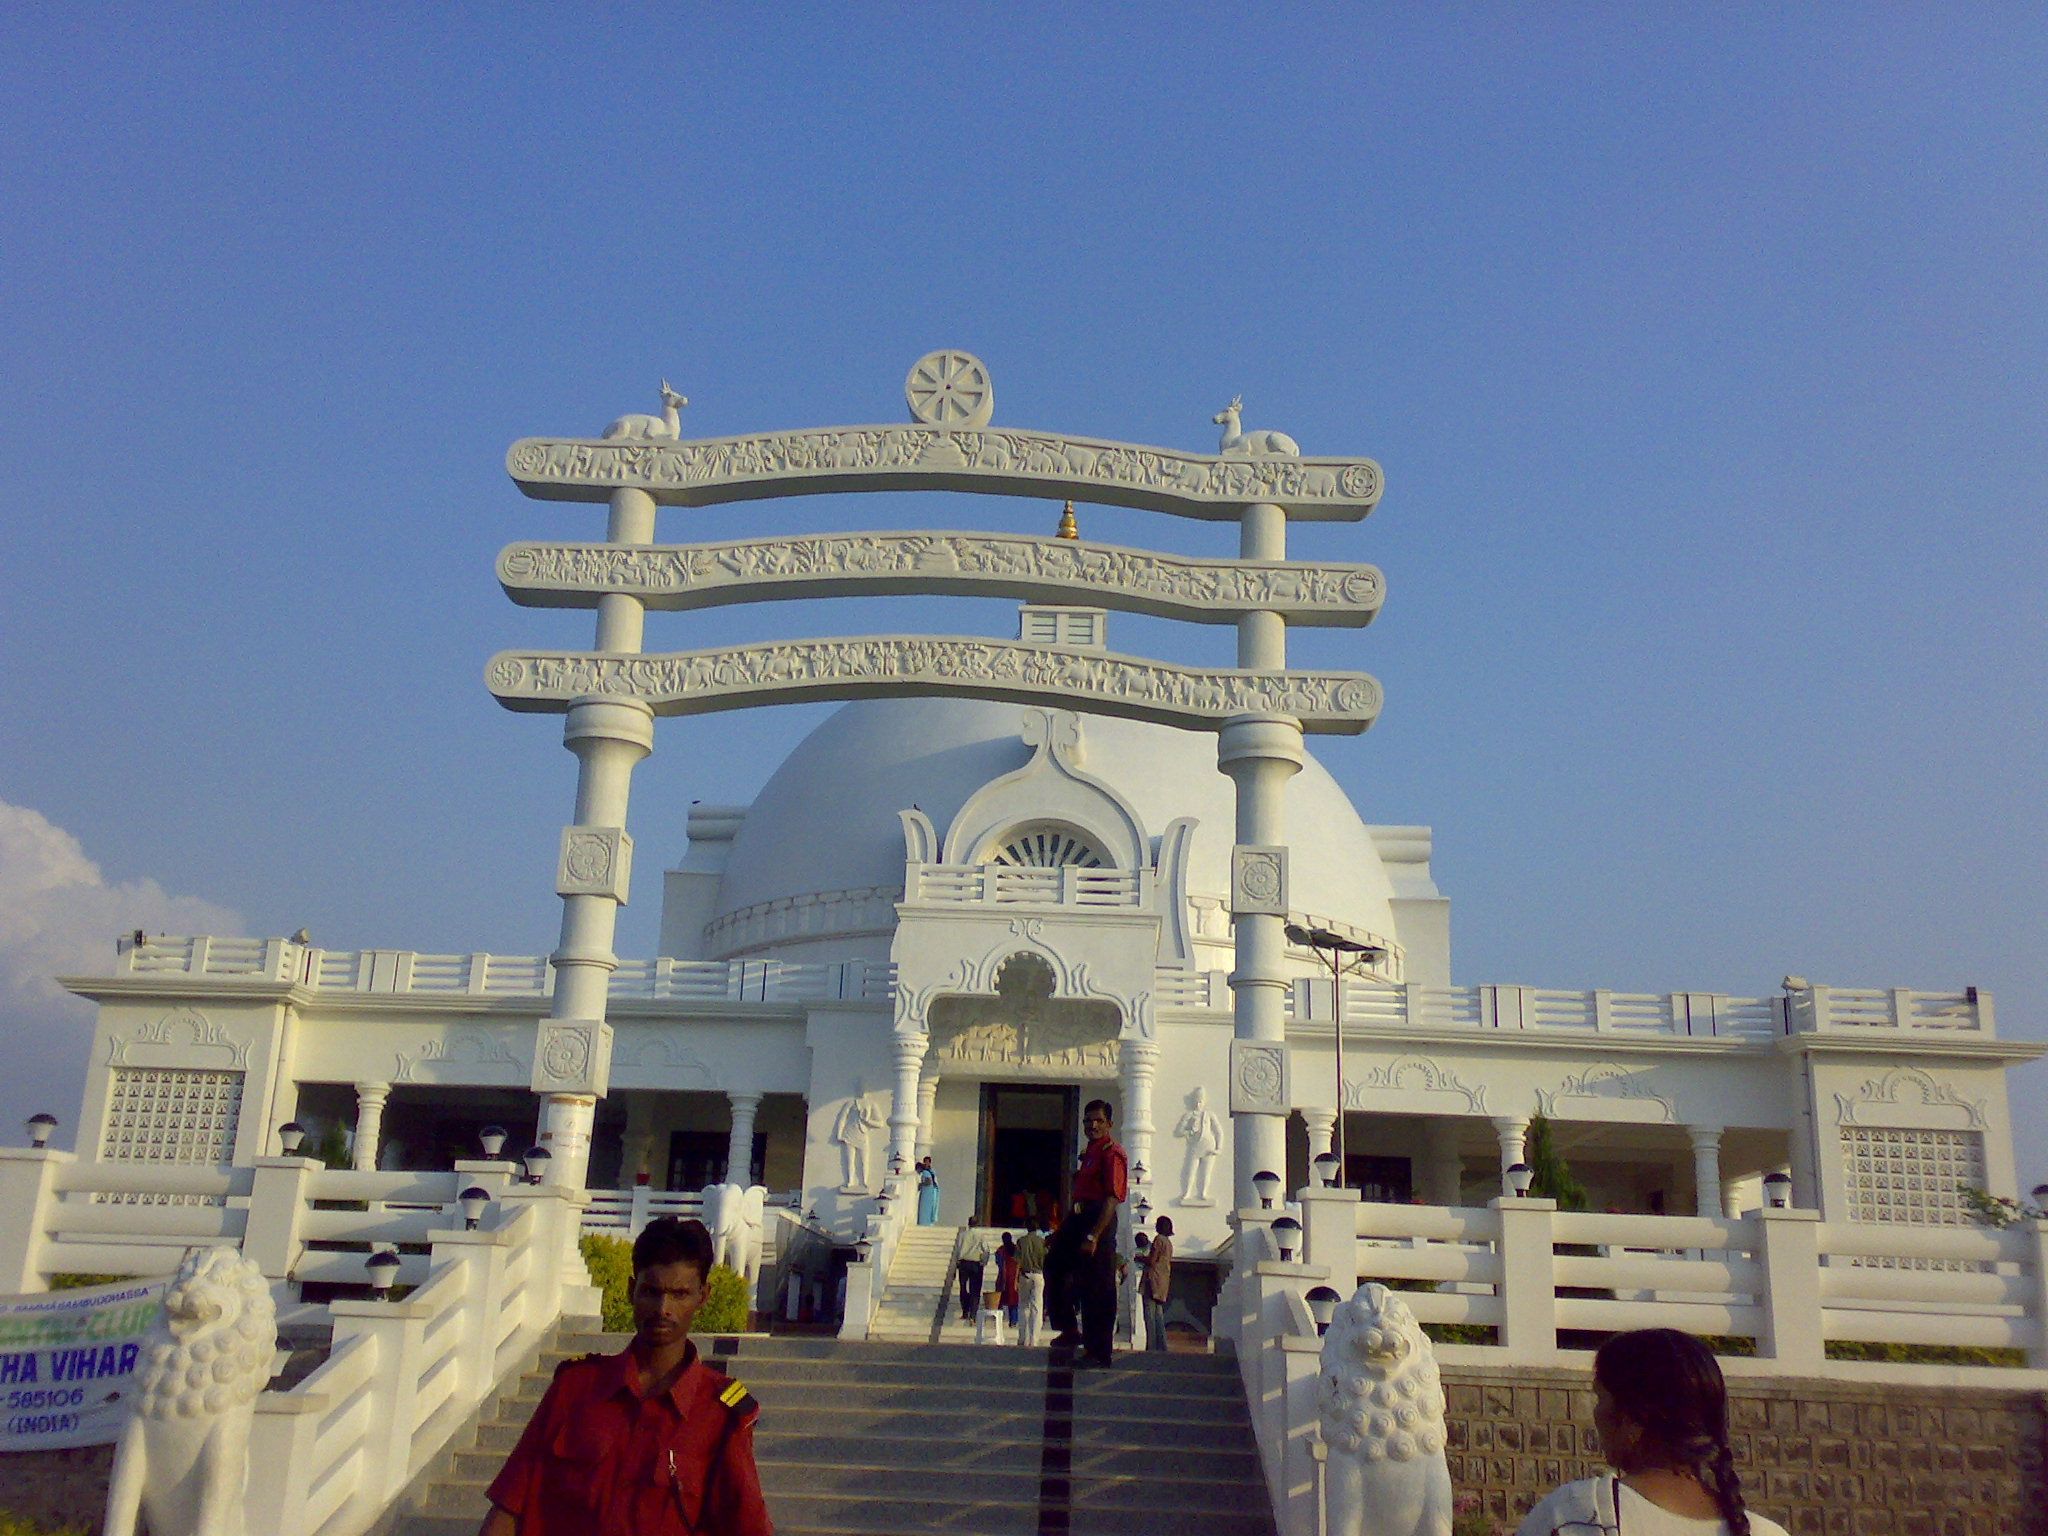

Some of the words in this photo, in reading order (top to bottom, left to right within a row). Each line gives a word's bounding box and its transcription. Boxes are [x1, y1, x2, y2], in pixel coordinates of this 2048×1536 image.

[0, 1353, 37, 1384] HA
[52, 1343, 139, 1381] VIHAR
[8, 1412, 80, 1435] (INDIA)
